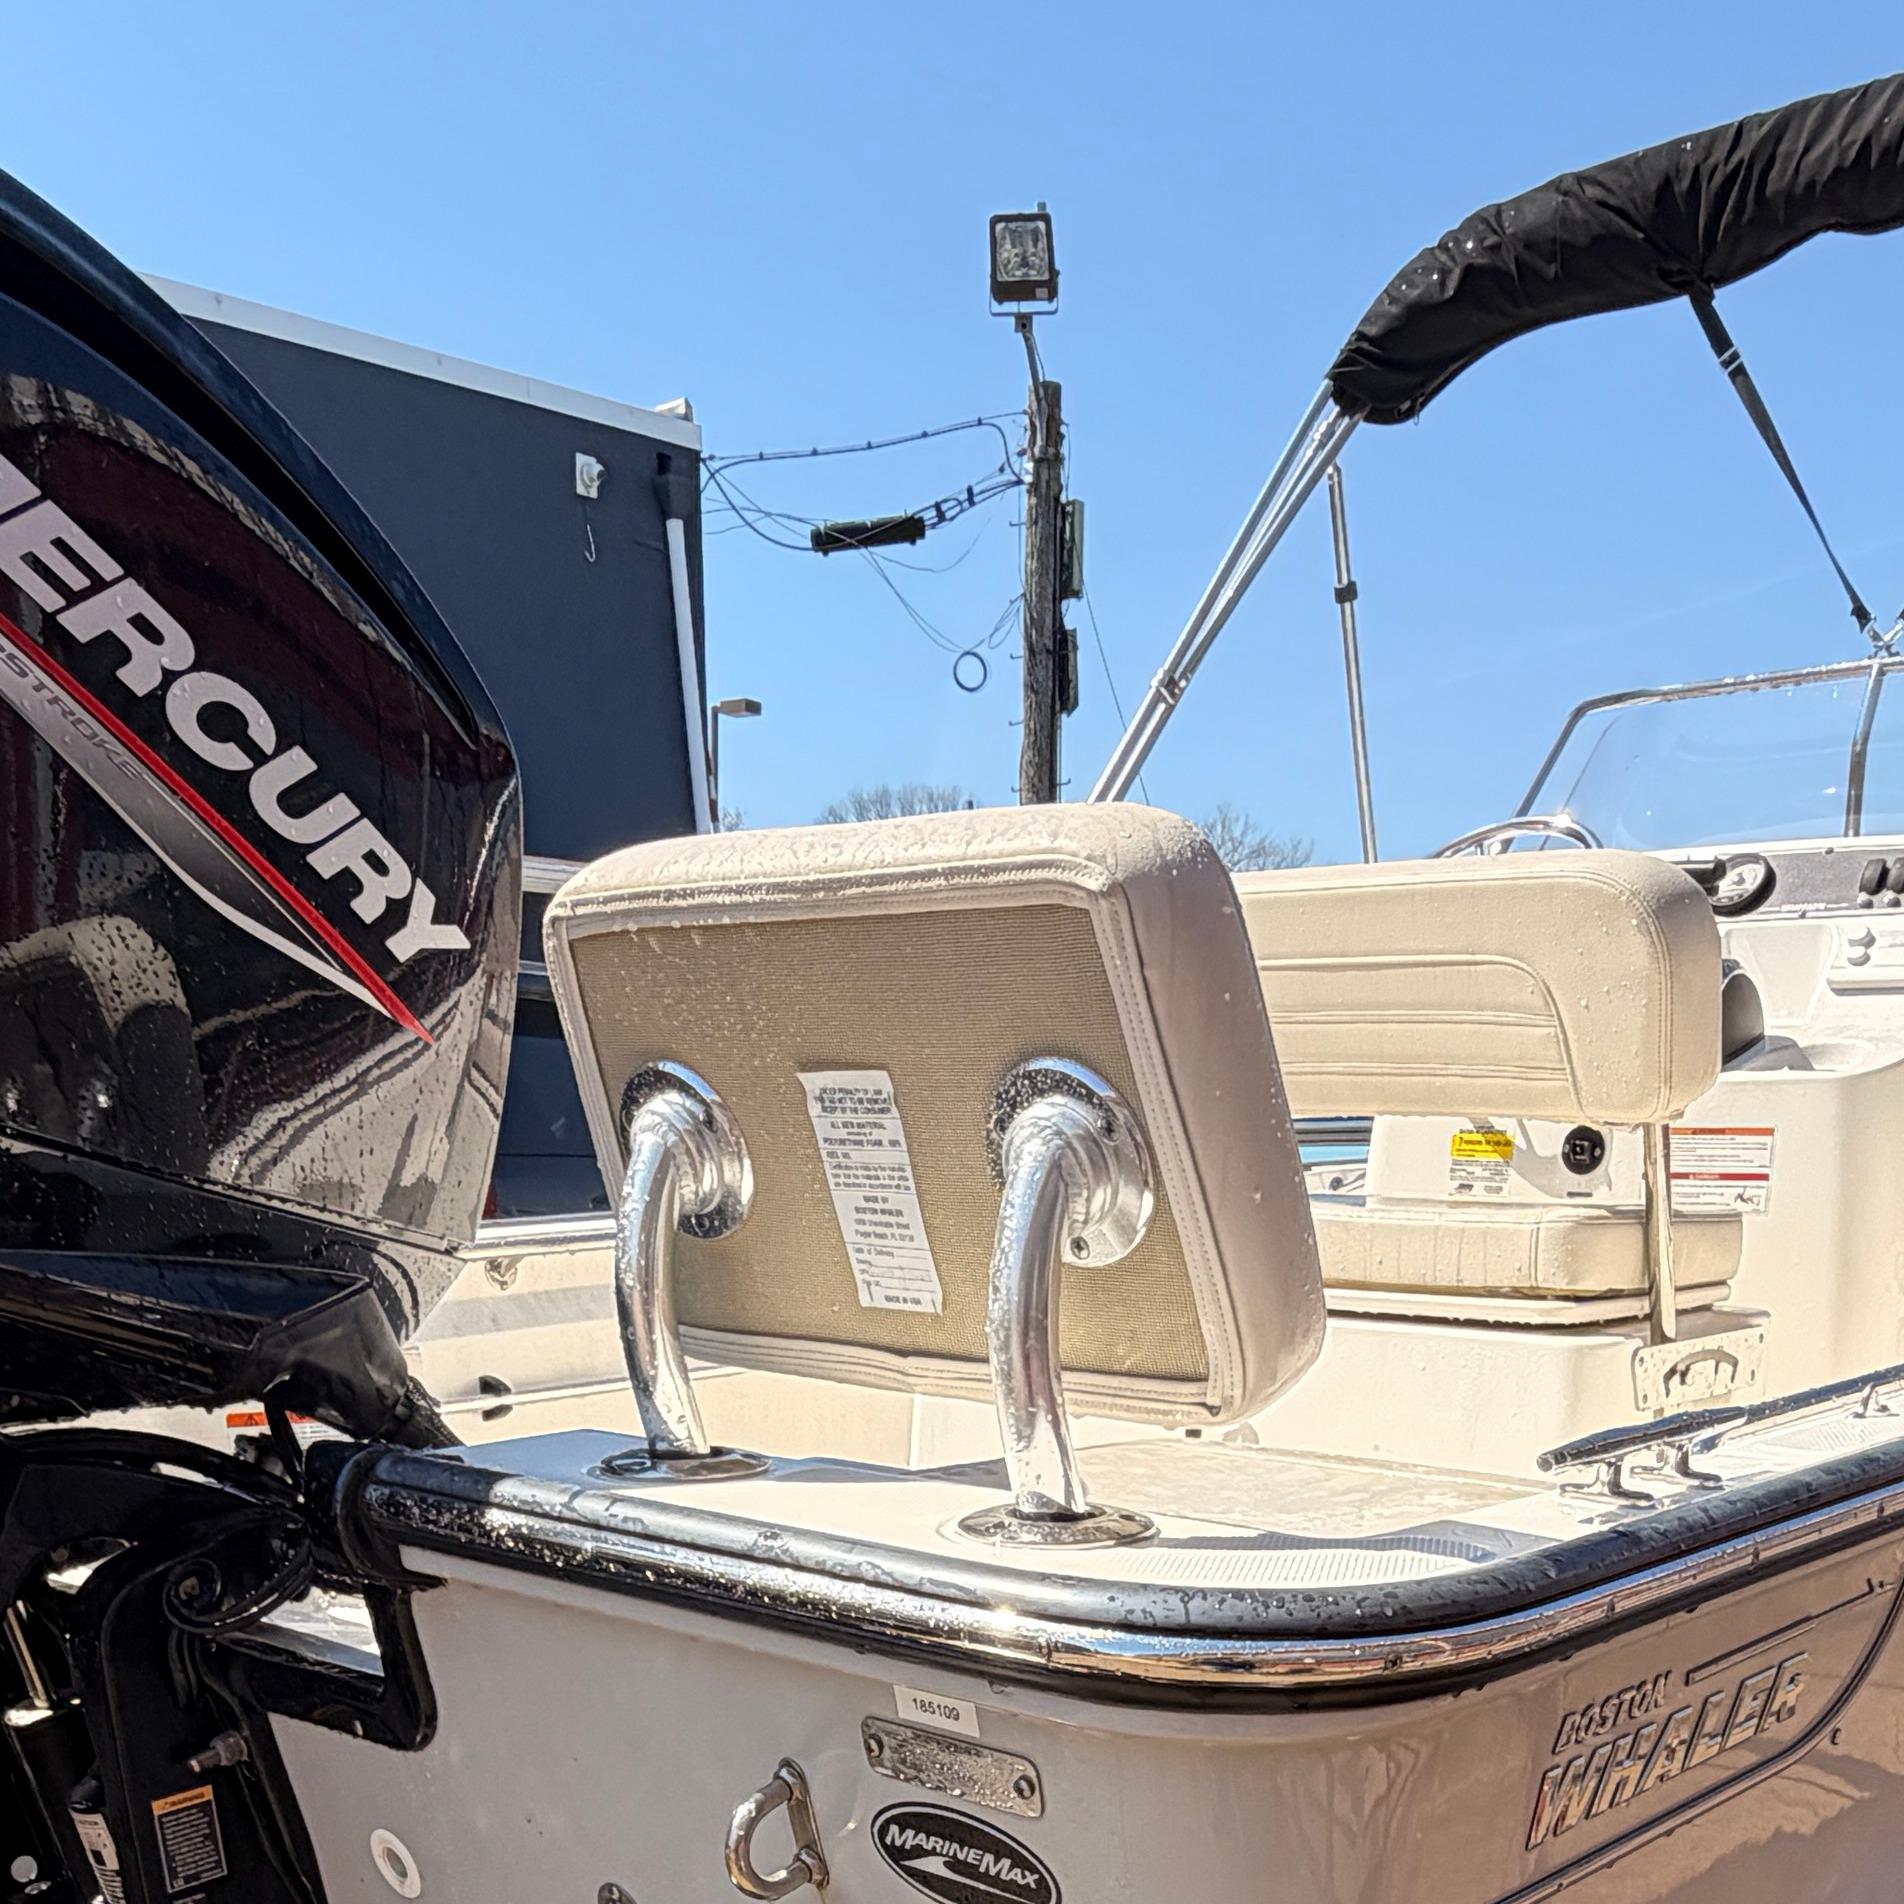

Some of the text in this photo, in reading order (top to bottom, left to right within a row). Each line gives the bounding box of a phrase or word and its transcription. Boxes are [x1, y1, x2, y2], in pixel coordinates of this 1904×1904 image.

[911, 1696, 961, 1723] 185109
[1526, 1651, 1810, 1851] WHALER
[1552, 1670, 1672, 1755] BOSTON
